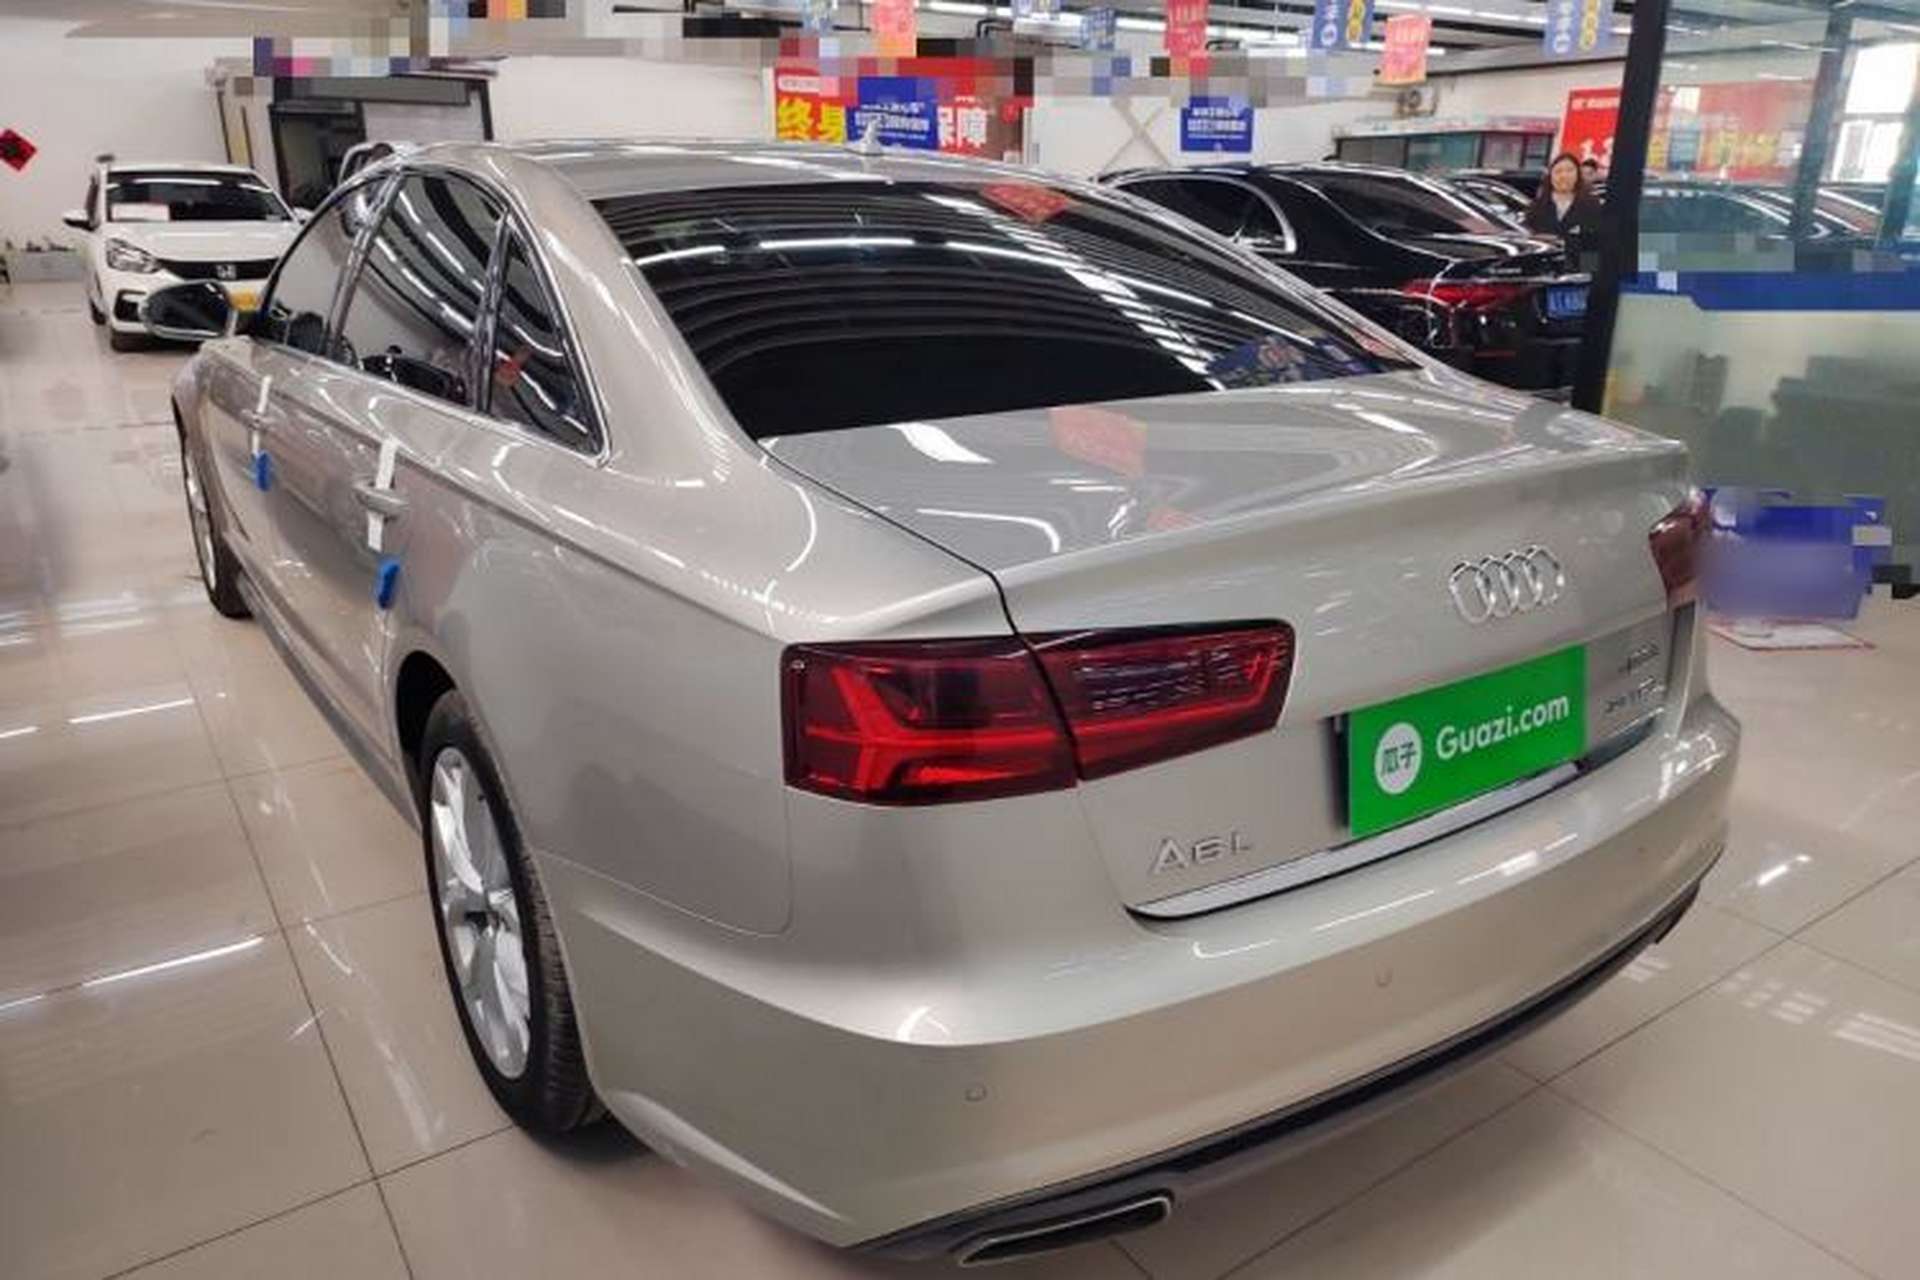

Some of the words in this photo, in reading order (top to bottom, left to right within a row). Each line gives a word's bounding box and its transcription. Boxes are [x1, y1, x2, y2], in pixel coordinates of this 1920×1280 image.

[1436, 696, 1569, 760] Guazi.com
[1381, 741, 1417, 775] 瓜子
[1146, 831, 1251, 875] A6L
